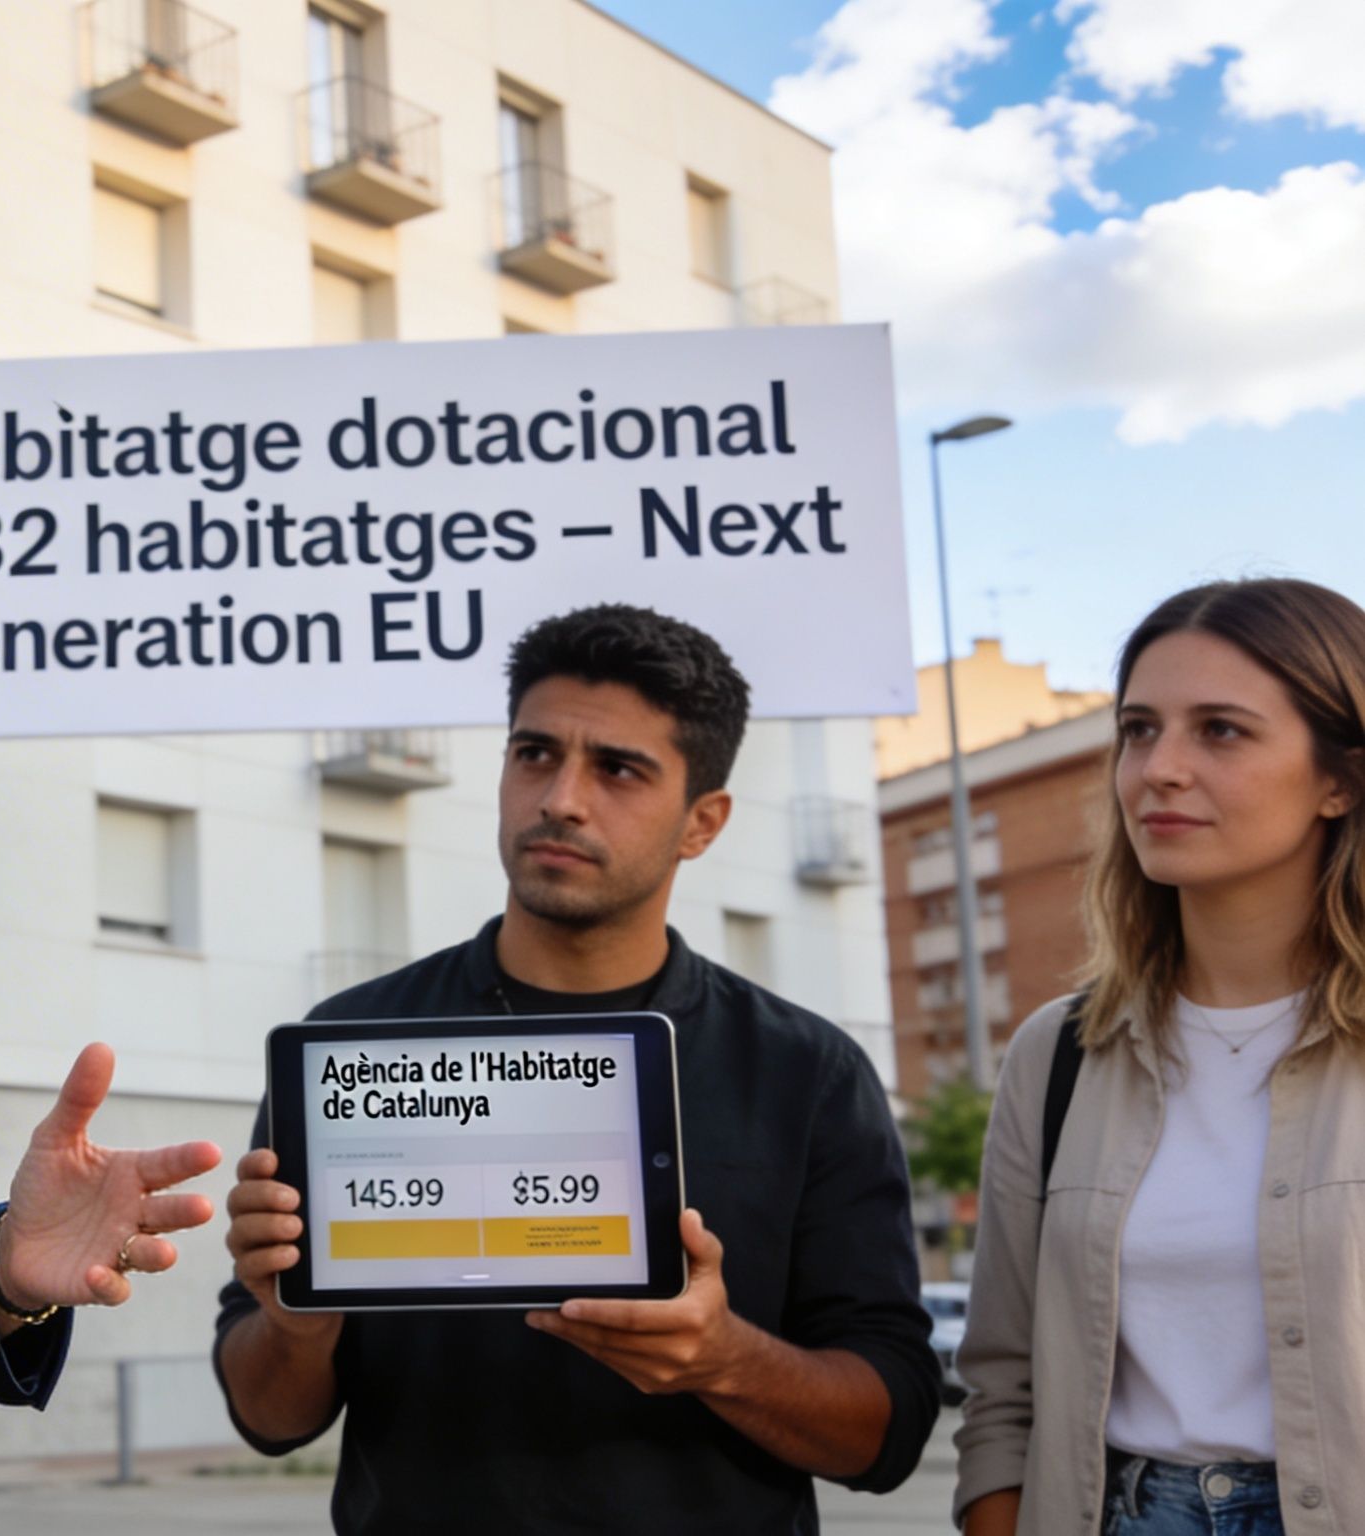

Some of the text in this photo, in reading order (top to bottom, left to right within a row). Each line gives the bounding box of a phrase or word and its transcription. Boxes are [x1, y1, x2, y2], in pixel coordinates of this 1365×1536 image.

[327, 380, 796, 470] dotacional
[85, 498, 538, 583] habitatges
[638, 484, 847, 559] Next
[370, 588, 484, 663] EU
[320, 1050, 617, 1092] Agència de l'Habitatge
[322, 1088, 491, 1126] de Catalunya
[344, 1170, 601, 1210] 145.99 $5.99
